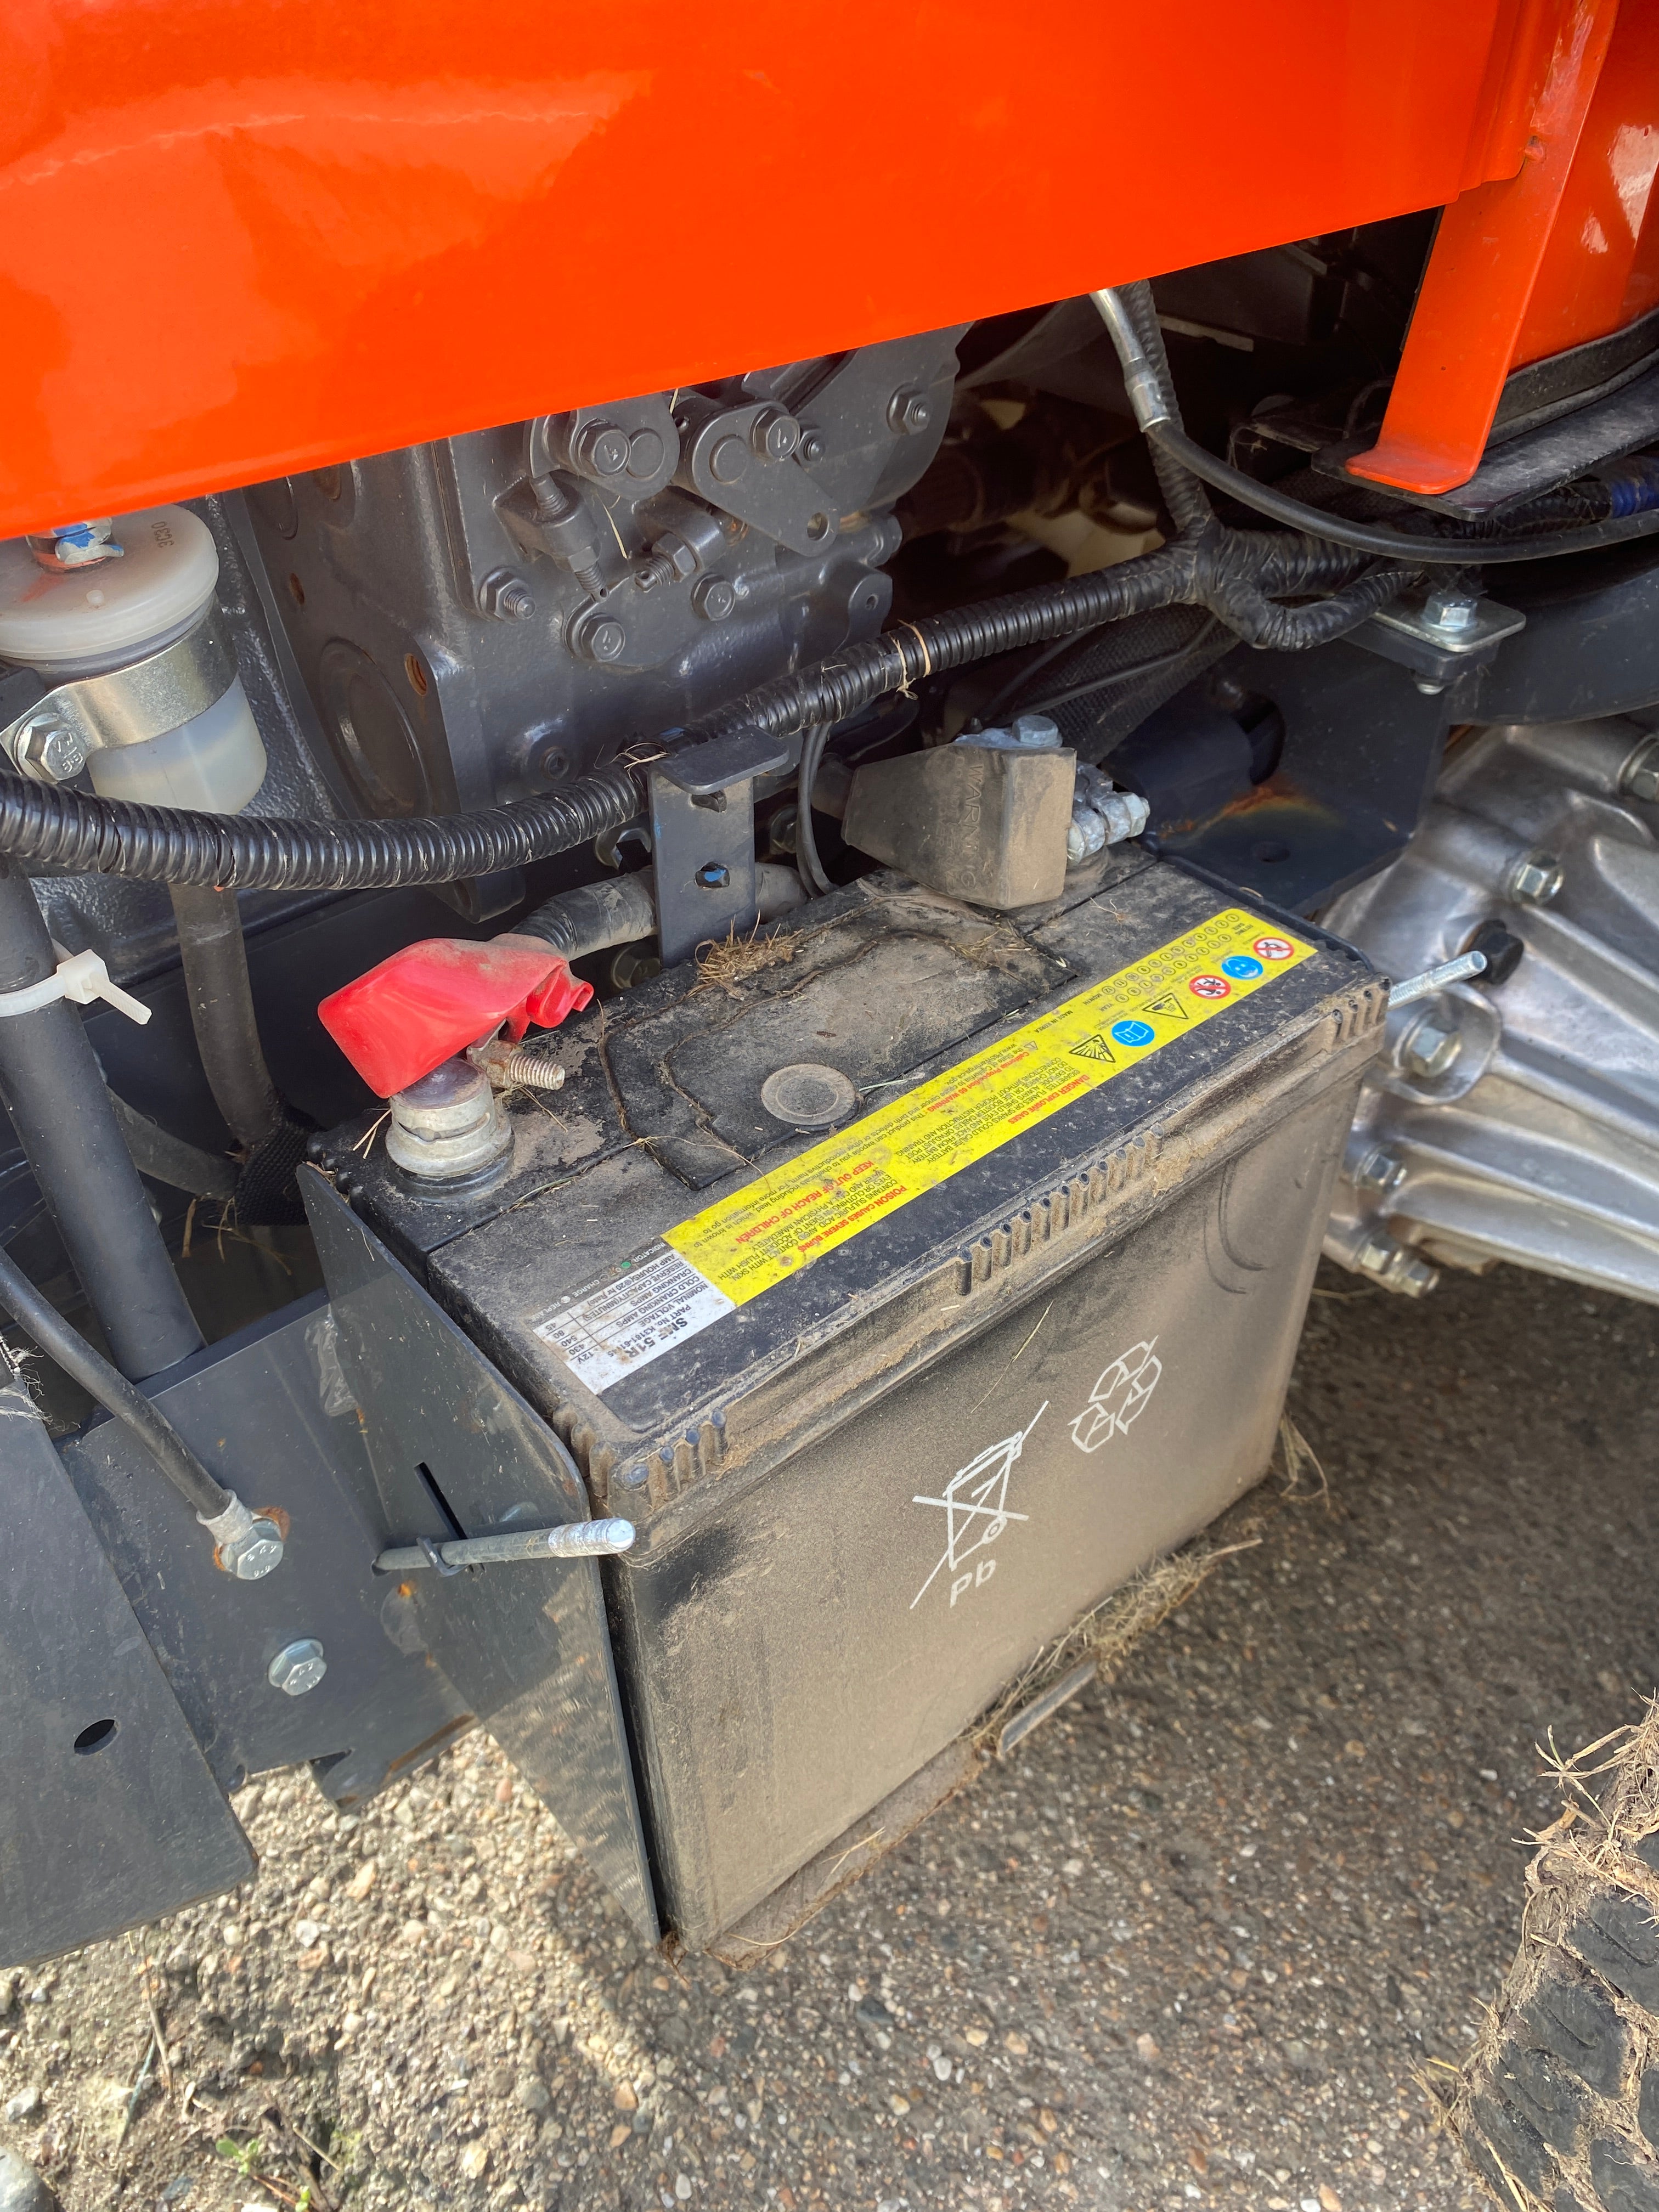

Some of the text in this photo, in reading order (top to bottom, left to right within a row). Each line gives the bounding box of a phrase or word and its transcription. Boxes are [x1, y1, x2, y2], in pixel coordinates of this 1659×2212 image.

[1081, 992, 1103, 1005] MONTH
[1057, 1009, 1074, 1020] MADE
[1098, 1002, 1114, 1012] YEAR
[1033, 1022, 1052, 1033] KOREA
[996, 1052, 1014, 1064] State
[1011, 1047, 1024, 1055] the
[998, 1050, 1030, 1070] California
[963, 1065, 993, 1083] California
[1044, 1065, 1059, 1075] NOT
[1021, 1073, 1048, 1089] CHARGE
[1001, 1092, 1016, 1102] USE
[1012, 1086, 1025, 1094] OR
[1015, 1085, 1041, 1101] ALWAYS
[1022, 1089, 1047, 1105] FLAMES
[893, 1056, 1062, 1158] CONNECTIONS WITHOUT PROPER INSTRUCTION AND TRAINING.
[918, 1094, 941, 1108] cancer
[926, 1091, 960, 1113] WARNING
[995, 1098, 1019, 1113] SHIELD
[1007, 1074, 1090, 1125] DANGER EXPLOSIVE GASES
[1012, 1102, 1025, 1110] OR
[906, 1106, 921, 1115] and
[974, 1098, 1004, 1118] BOOSTER
[980, 1109, 999, 1121] EYES
[990, 1107, 1016, 1124] SPARKS
[892, 1113, 910, 1124] birth
[909, 1112, 925, 1122] This
[952, 1114, 978, 1131] CABLES
[968, 1119, 984, 1129] AND
[870, 1121, 895, 1137] defects
[885, 1119, 912, 1136] product
[952, 1126, 972, 1138] FACE
[970, 1121, 994, 1136] COULD
[873, 1133, 888, 1142] can
[935, 1135, 956, 1148] FROM
[950, 1133, 974, 1148] CAUSE
[845, 1139, 865, 1152] other
[850, 1139, 876, 1156] expose
[838, 1153, 853, 1163] you
[903, 1147, 923, 1160] POST
[909, 1146, 938, 1164] BATTERY
[924, 1145, 954, 1164] BATTERY
[805, 1148, 848, 1175] reproductive
[799, 1165, 834, 1187] chemicals
[872, 1173, 892, 1187] EYES
[768, 1183, 802, 1204] including
[776, 1182, 790, 1192] For
[847, 1181, 865, 1193] AND
[862, 1183, 876, 1193] OR
[864, 1178, 899, 1200] CONTAINS
[734, 1159, 874, 1244] KEEP OUT OF REACH OF CHILDREN
[758, 1189, 777, 1201] more
[720, 1199, 761, 1224] information
[792, 1203, 829, 1226] PHYSICIAN
[833, 1197, 868, 1218] SULFURIC
[709, 1220, 722, 1229] go
[731, 1211, 755, 1226] which
[796, 1184, 907, 1252] POISON CAUSES SEVERE BURNS
[800, 1214, 825, 1230] EVENT
[701, 1227, 727, 1244] known
[790, 1226, 804, 1236] OF
[757, 1232, 794, 1256] ACCIDENT
[764, 1238, 800, 1261] CONTACT
[631, 1241, 666, 1263] INDICATOR
[657, 1253, 676, 1266] AMP
[735, 1252, 760, 1269] FLUSH
[747, 1256, 769, 1271] WITH
[649, 1260, 684, 1283] RESERVE
[716, 1266, 738, 1280] WITH
[571, 1278, 601, 1297] CHARGE
[606, 1288, 617, 1296] hr
[559, 1267, 692, 1347] CRANKING AMPS 540
[667, 1304, 692, 1320] PART
[567, 1275, 701, 1356] COLD CRANKING AMPS 430
[575, 1282, 709, 1364] NOMINAL VOLTAGE 12V
[544, 1321, 558, 1331] 45
[551, 1329, 566, 1339] 80
[623, 1336, 657, 1359] 51R
[950, 1559, 996, 1609] Pb
